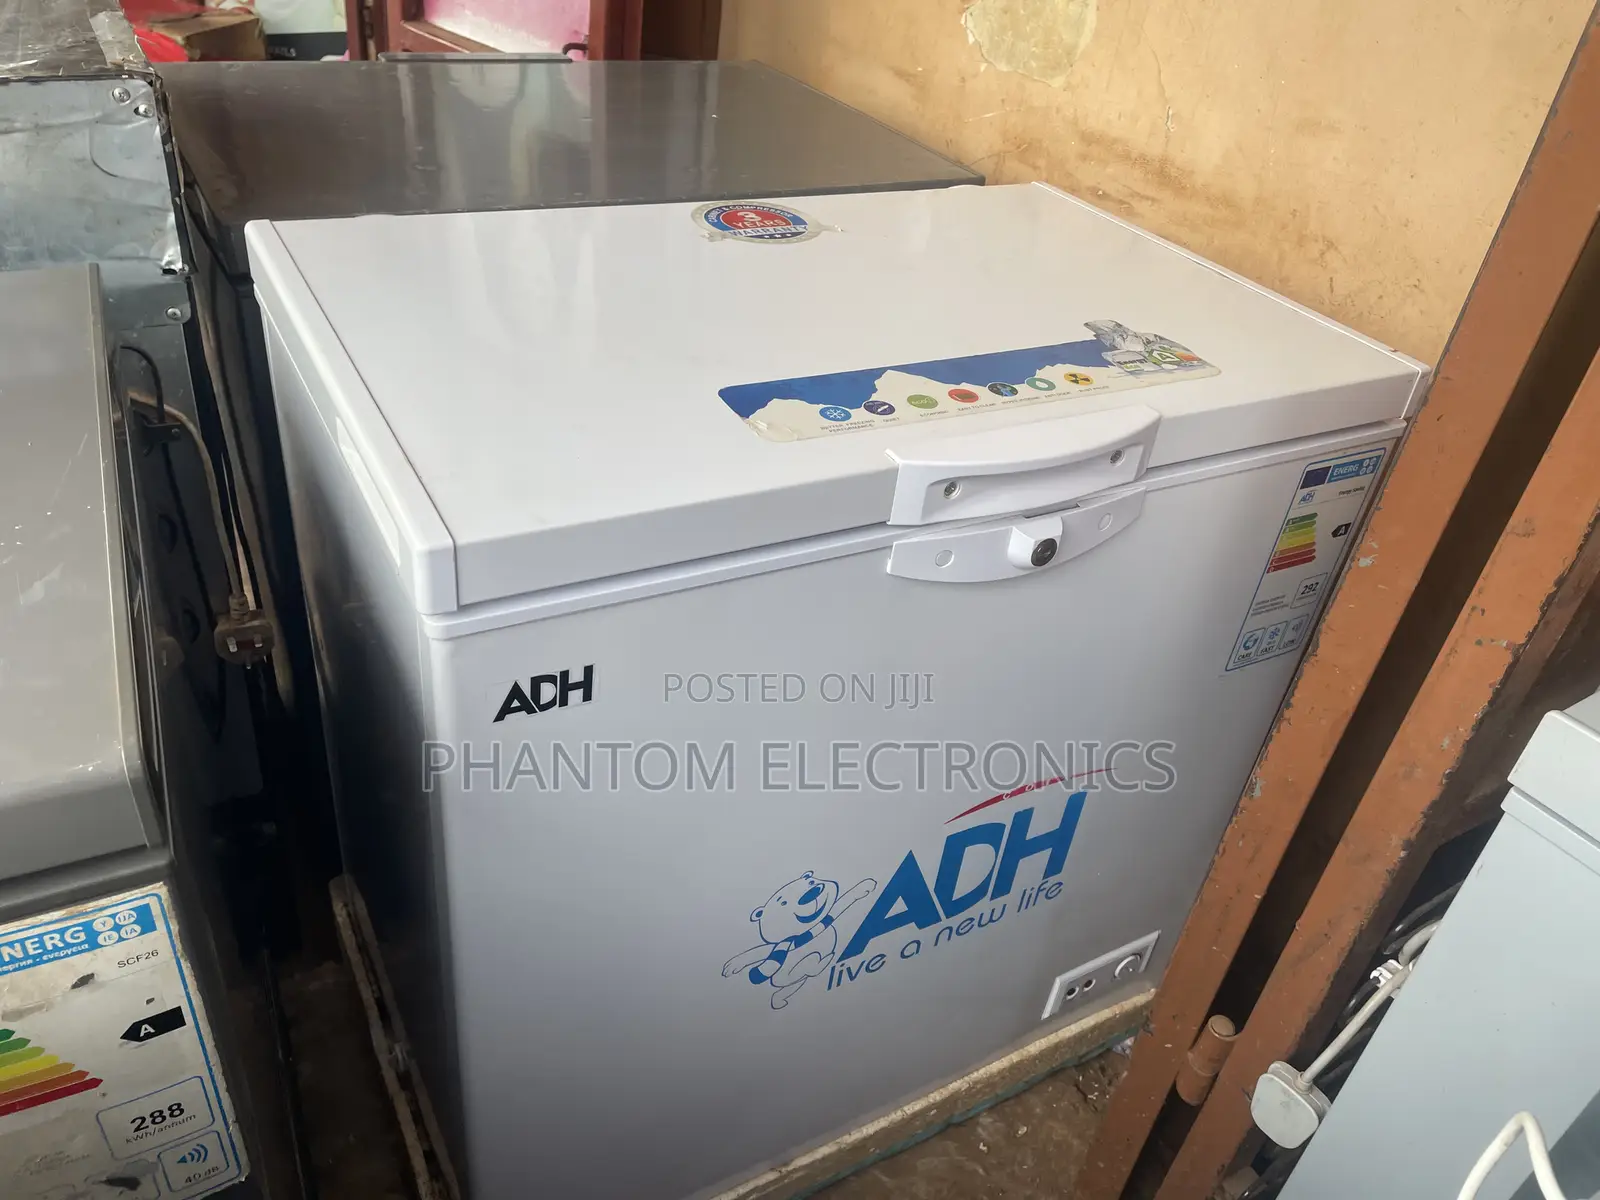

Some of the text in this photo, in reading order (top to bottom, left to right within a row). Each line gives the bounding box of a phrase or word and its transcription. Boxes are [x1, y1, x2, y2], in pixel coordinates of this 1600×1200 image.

[730, 204, 794, 219] COMPRESSOR
[737, 211, 762, 222] 3
[732, 218, 787, 229] YEARS
[728, 225, 809, 238] WARRANTY
[1333, 463, 1360, 476] ENERG
[1337, 525, 1346, 536] A
[1300, 581, 1320, 596] 292
[493, 664, 595, 723] ADH
[836, 791, 1087, 962] ADH
[103, 927, 138, 943] IE IA
[827, 880, 1064, 991] live a new life
[0, 926, 87, 963] NERG
[117, 949, 159, 969] SCF26
[139, 1023, 155, 1037] A
[130, 1102, 185, 1133] 288
[184, 1173, 202, 1184] 40
